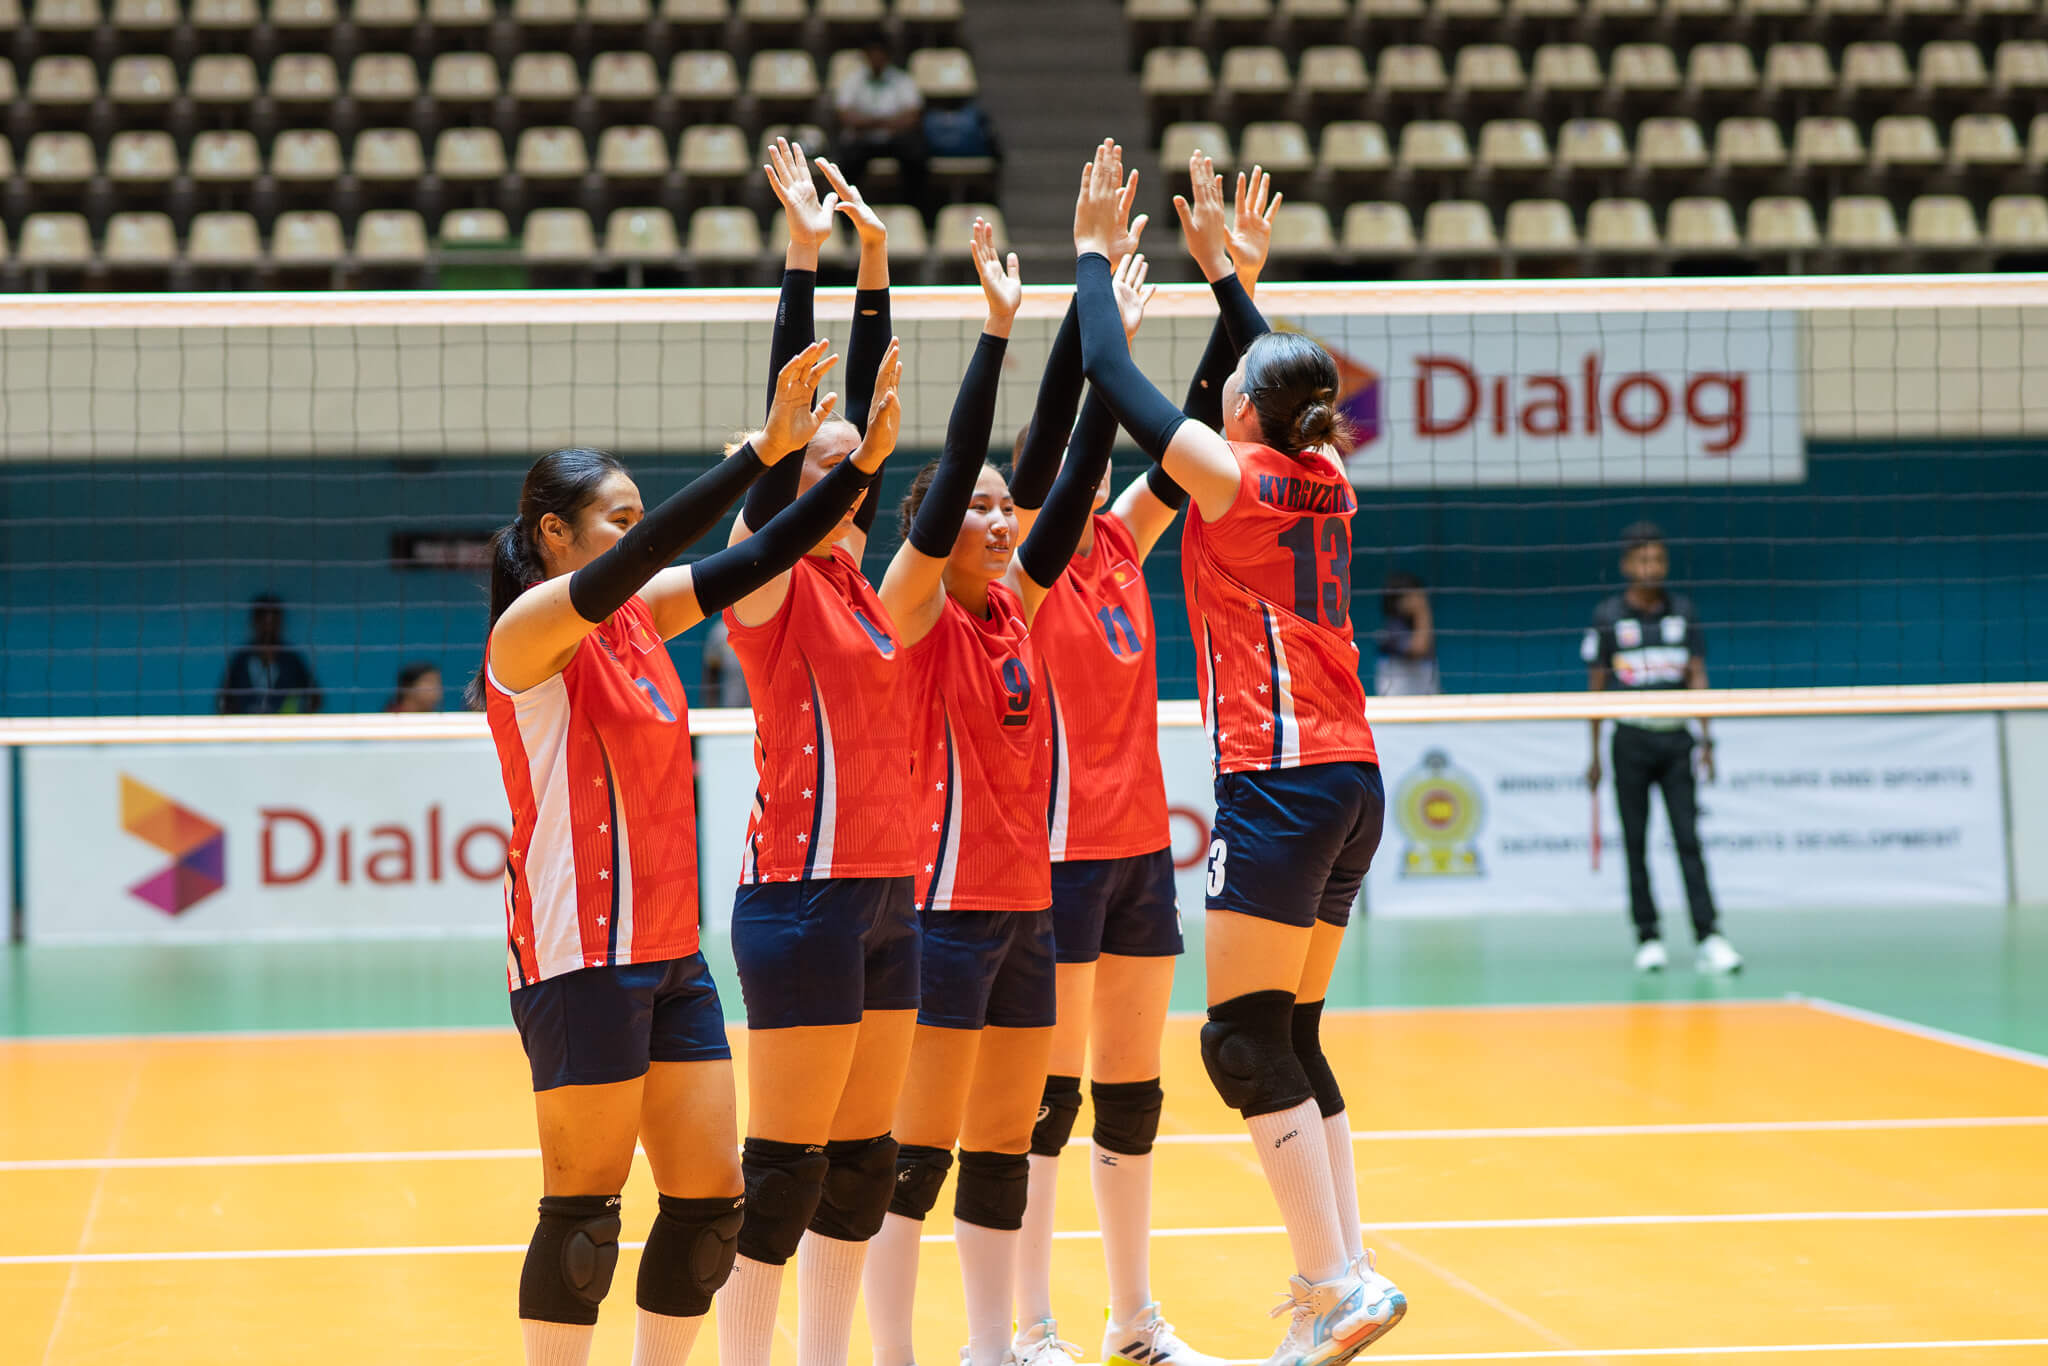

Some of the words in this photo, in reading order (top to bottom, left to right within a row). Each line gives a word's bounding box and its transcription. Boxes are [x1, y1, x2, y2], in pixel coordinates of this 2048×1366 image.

[1413, 351, 1746, 456] Dialog
[1278, 516, 1350, 629] 13
[1097, 605, 1143, 655] 11
[1002, 657, 1031, 712] 9
[1207, 838, 1227, 896] 3
